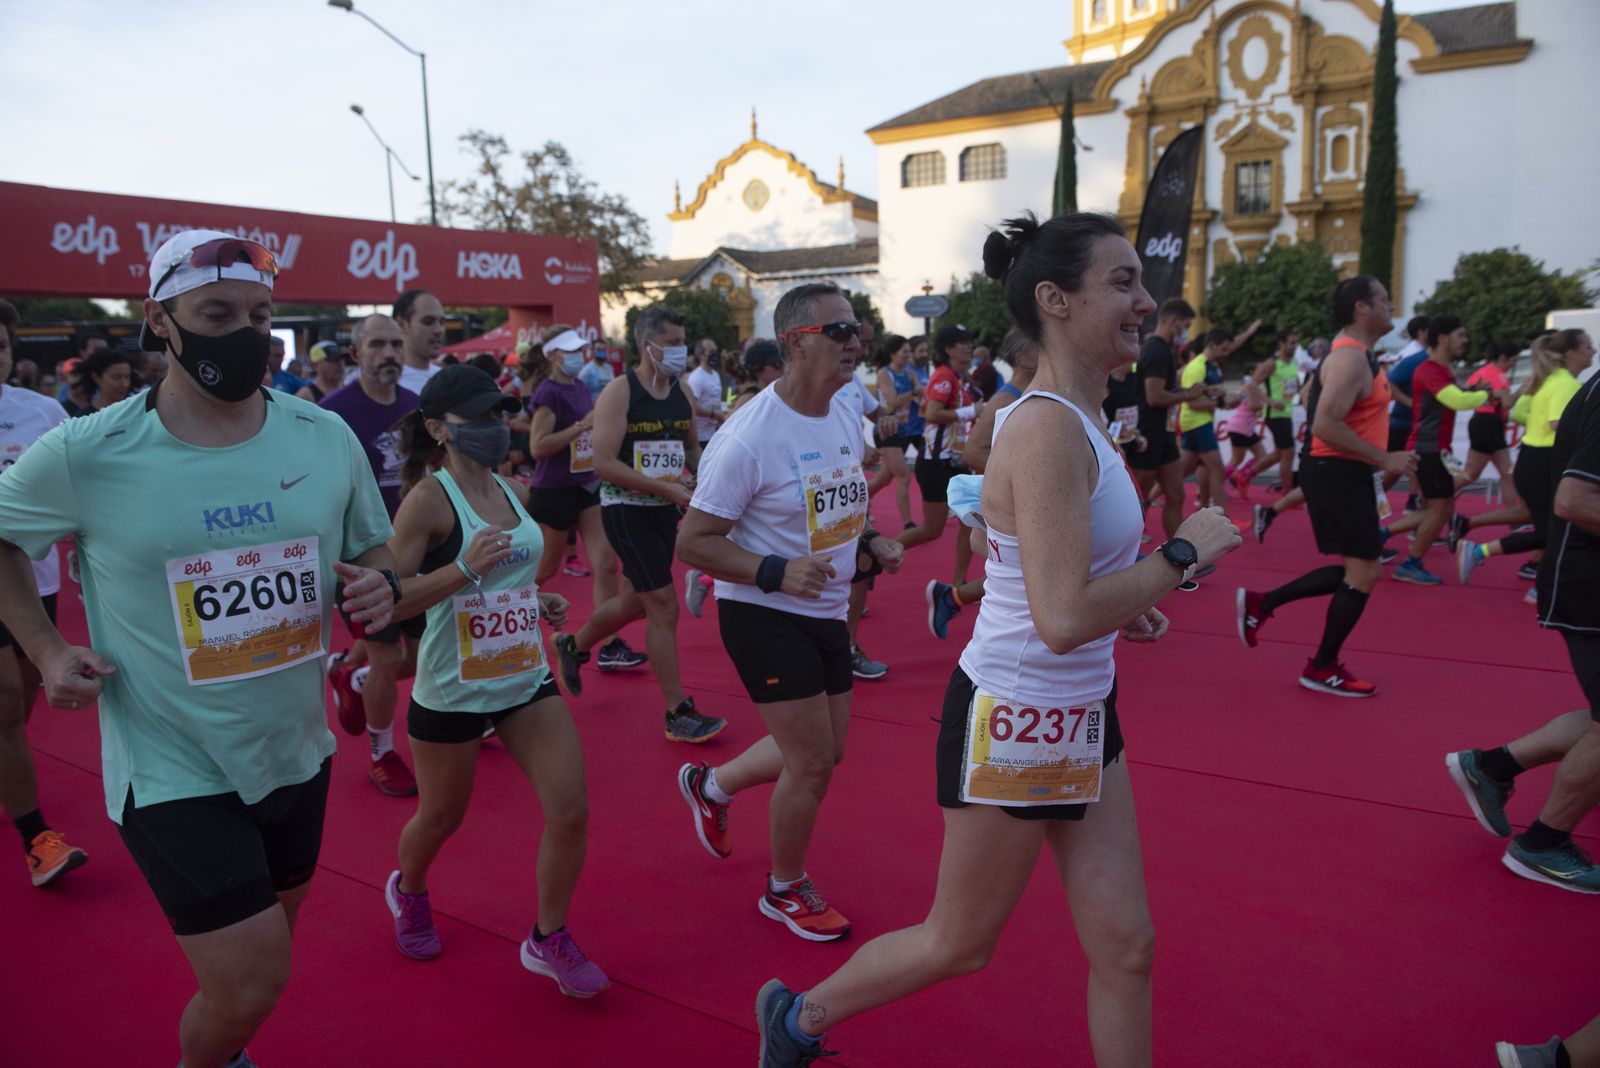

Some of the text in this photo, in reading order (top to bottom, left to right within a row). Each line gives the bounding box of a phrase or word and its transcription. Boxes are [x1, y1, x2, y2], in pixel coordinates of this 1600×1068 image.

[50, 214, 120, 265] edp
[1144, 231, 1183, 263] edp
[347, 229, 420, 293] edp
[457, 250, 523, 280] HOKA
[641, 453, 678, 468] 6736
[799, 451, 822, 462] HOKA
[814, 482, 859, 513] 6793
[203, 501, 275, 531] KUKI
[236, 550, 261, 568] edp
[283, 543, 307, 560] edp
[184, 558, 213, 577] edp
[193, 570, 297, 622] 6260
[468, 607, 530, 640] 6263
[199, 632, 240, 648] MANUEL
[989, 705, 1087, 744] 6237
[984, 755, 1011, 765] MARIA
[1012, 758, 1048, 767] ANGELES
